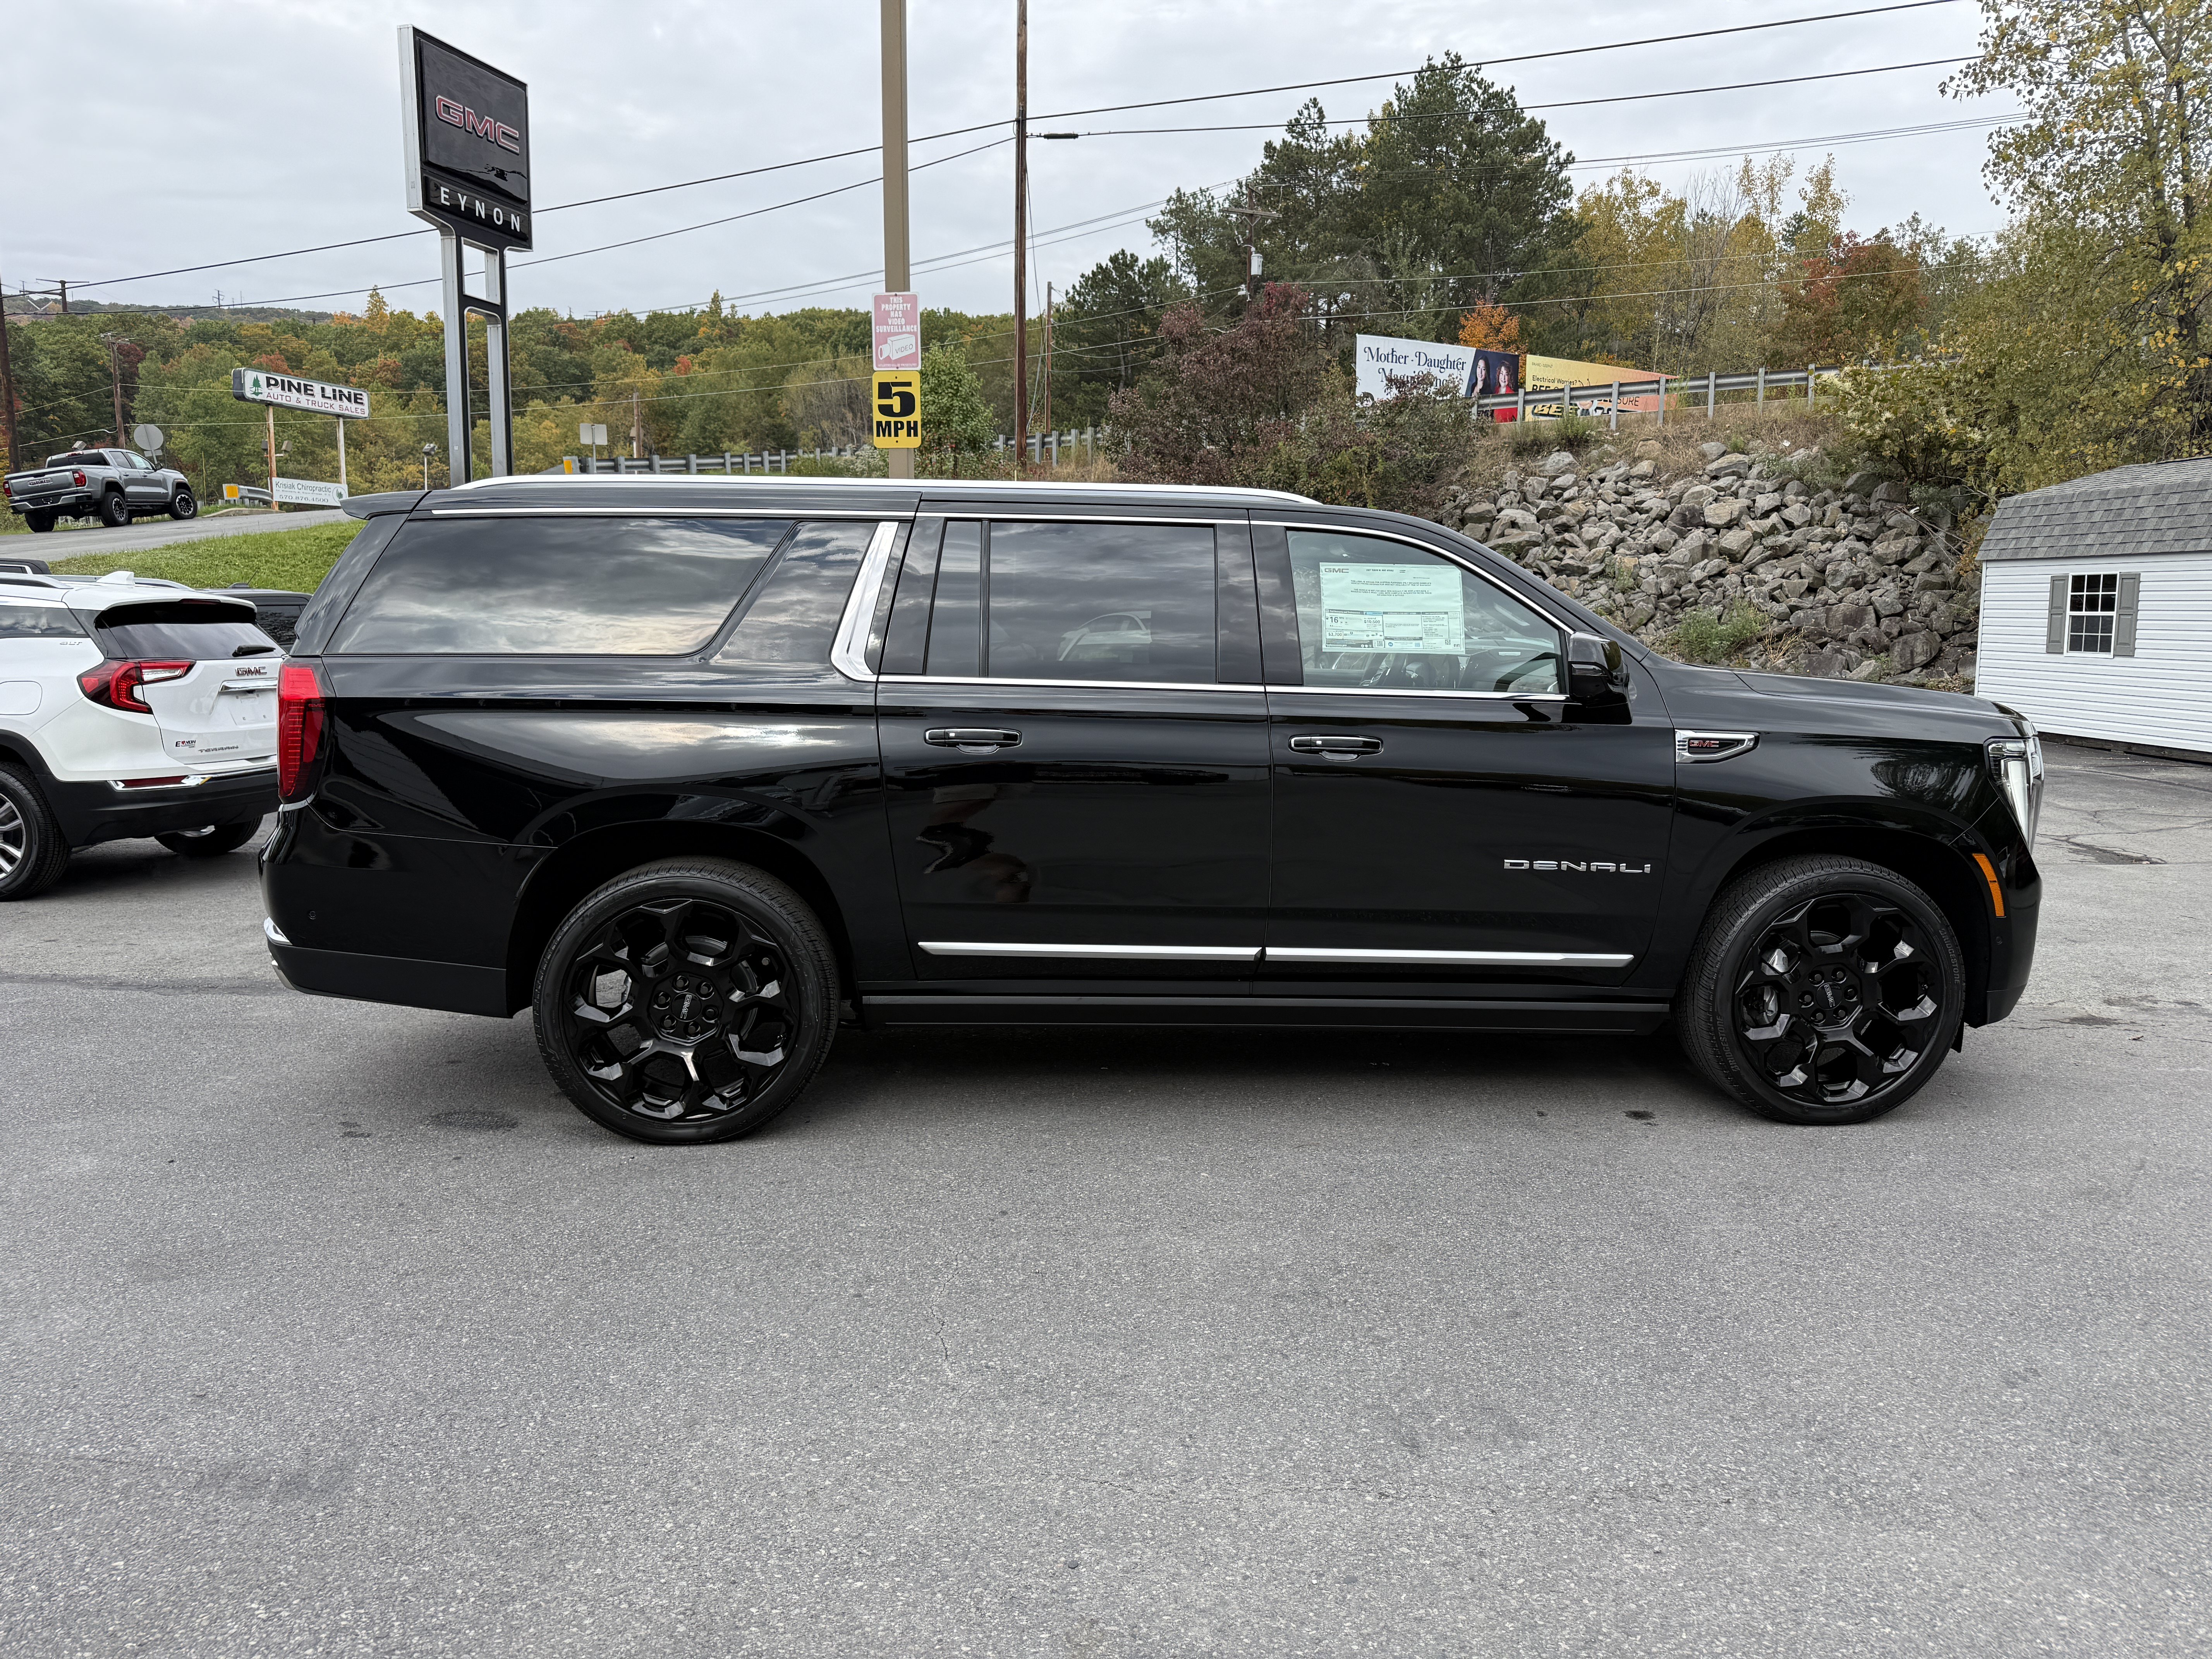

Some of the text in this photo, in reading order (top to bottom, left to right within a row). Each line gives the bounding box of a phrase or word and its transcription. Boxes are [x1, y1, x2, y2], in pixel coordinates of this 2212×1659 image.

[436, 95, 519, 155] GMC
[441, 186, 520, 232] EYNON
[895, 344, 913, 354] VIDEO
[1364, 346, 1409, 364] Mother
[1415, 351, 1467, 373] Daughter
[1532, 375, 1556, 383] Electrical
[266, 376, 365, 406] PINE LINE
[878, 381, 915, 417] 5
[266, 393, 291, 402] AUTO
[306, 399, 335, 410] TRUCK
[339, 405, 365, 415] SALES
[876, 421, 918, 437] MPH
[297, 483, 331, 493] Chiropractic
[235, 666, 267, 677] GMC
[1504, 859, 1651, 874] DENALI
[1787, 878, 1821, 893] ALENZA
[680, 994, 692, 1019] GMC
[1824, 984, 1835, 1007] GMC
[1716, 1015, 1740, 1072] BRIDGESTONE
